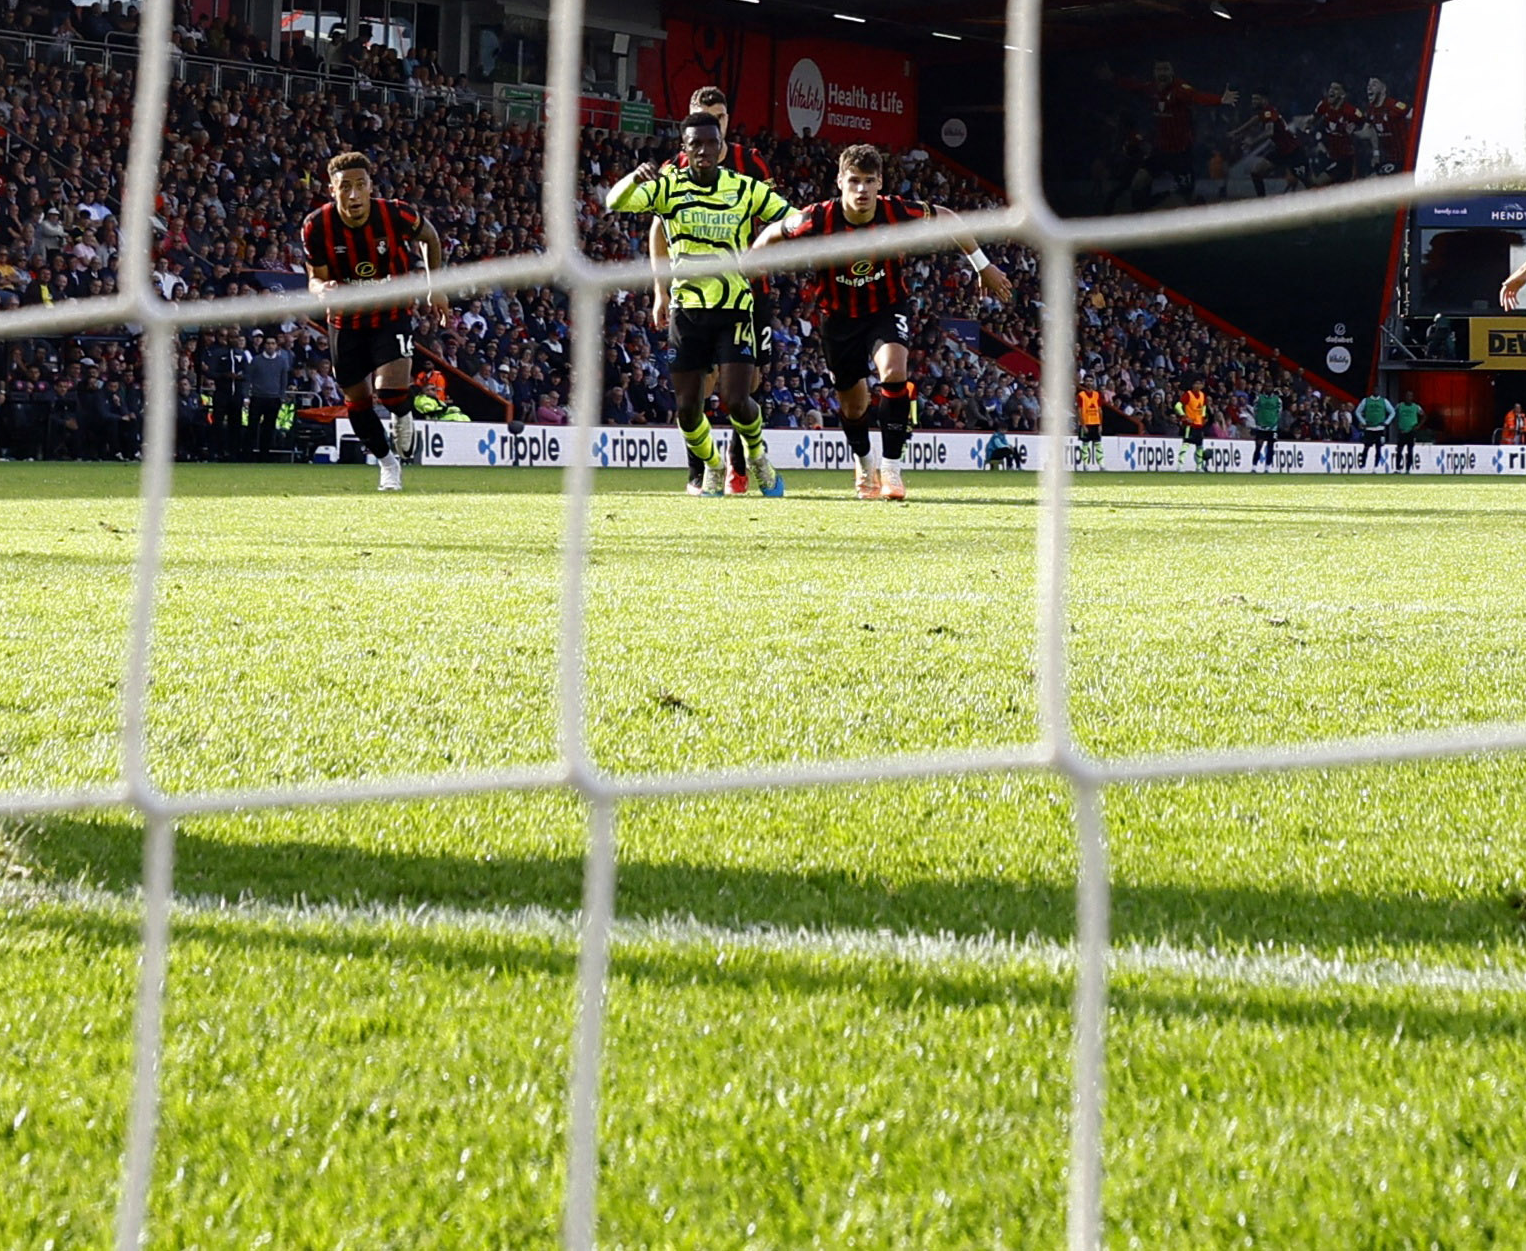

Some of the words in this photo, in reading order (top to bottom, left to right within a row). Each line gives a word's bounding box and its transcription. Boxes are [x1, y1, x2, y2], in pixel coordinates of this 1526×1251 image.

[789, 78, 824, 121] Vitality
[828, 82, 868, 109] Health
[870, 93, 878, 111] &
[880, 90, 904, 115] Life
[827, 107, 872, 131] insurance
[680, 207, 742, 226] Emirates
[836, 268, 886, 287] dafabet
[734, 322, 752, 347] 14
[894, 313, 909, 333] 3
[761, 325, 772, 351] 2
[611, 431, 669, 463] ripple
[813, 433, 856, 465] rippl
[1138, 443, 1174, 472] ripple
[1446, 447, 1476, 475] ripple
